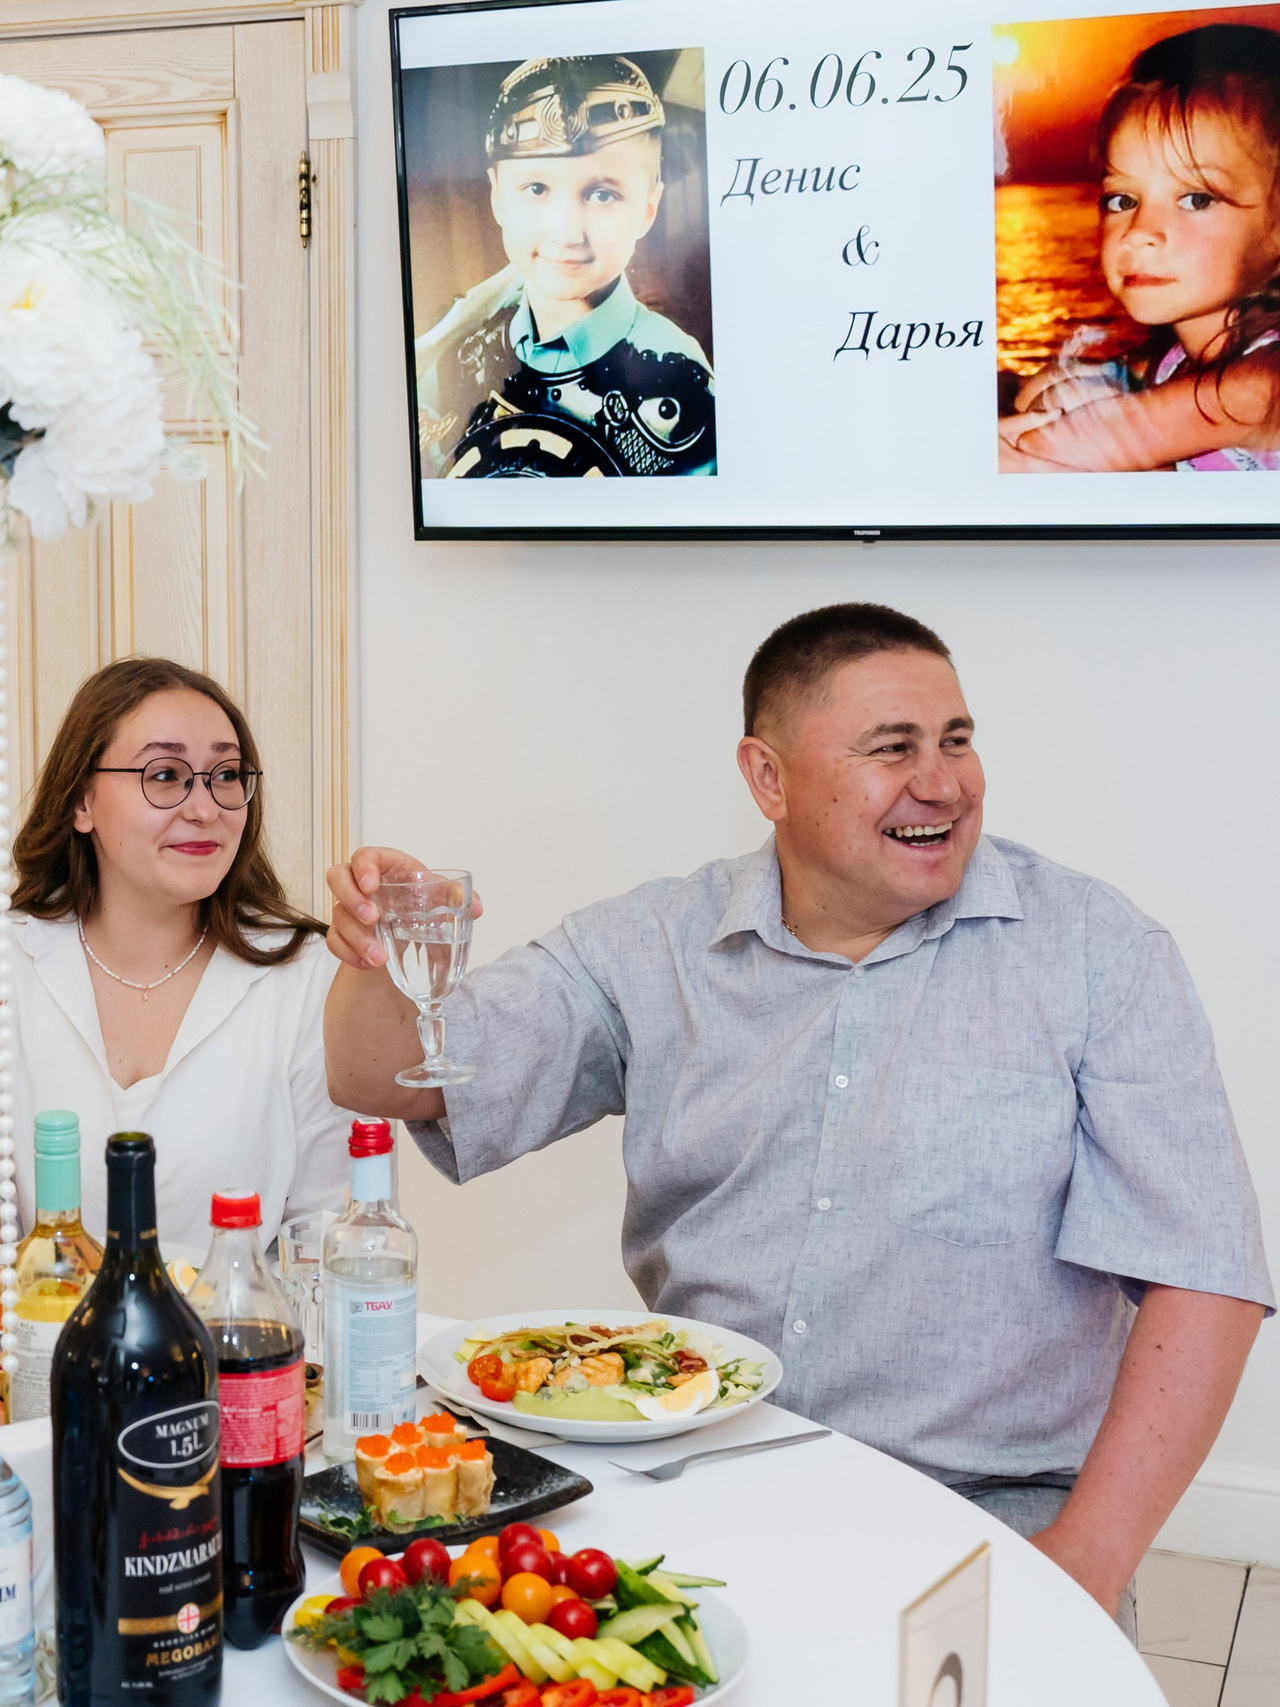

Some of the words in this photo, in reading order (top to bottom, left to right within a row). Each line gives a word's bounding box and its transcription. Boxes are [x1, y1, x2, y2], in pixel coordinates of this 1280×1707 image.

[719, 42, 973, 114] 06.06.25
[720, 157, 861, 208] Денис
[842, 224, 880, 266] &
[833, 310, 984, 361] Дарья
[364, 1300, 393, 1311] ТБАУ
[155, 1412, 209, 1440] MAGNUM
